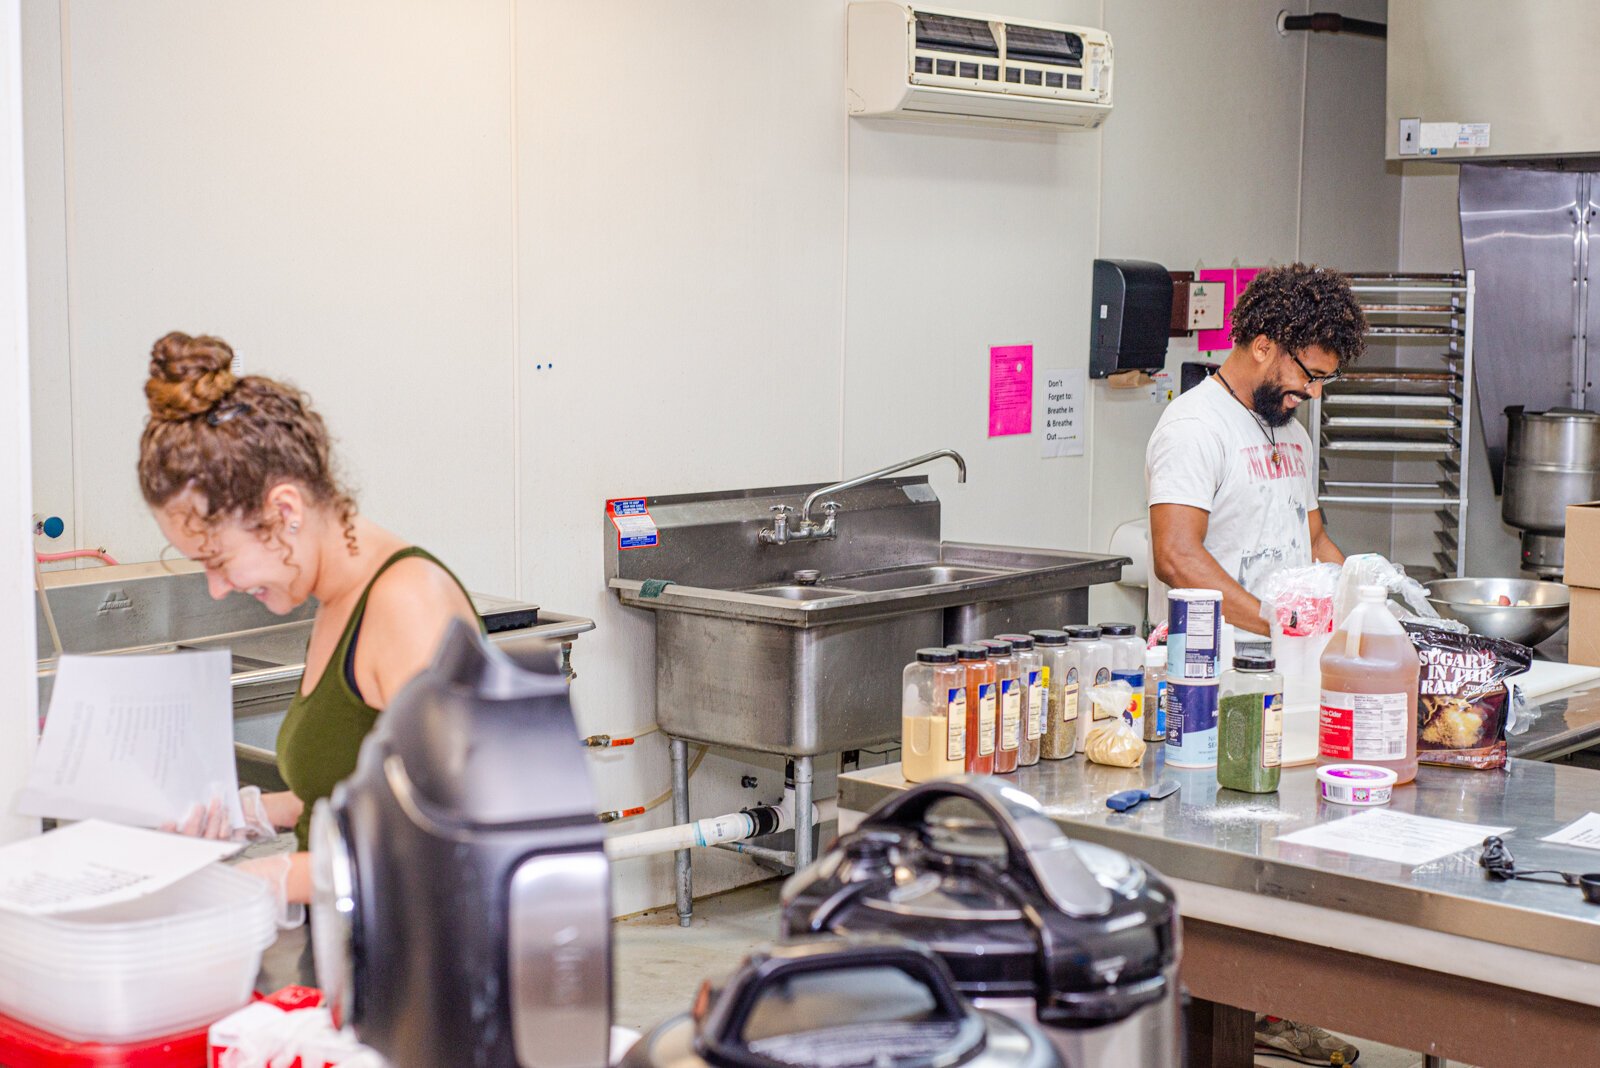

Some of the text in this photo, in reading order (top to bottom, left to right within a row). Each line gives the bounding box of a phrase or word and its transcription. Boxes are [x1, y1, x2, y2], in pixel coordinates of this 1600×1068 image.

[1048, 393, 1064, 401] Forget
[1047, 406, 1067, 414] Breathe
[1419, 650, 1483, 669] SUGAR
[1427, 664, 1494, 684] IN THE
[1420, 679, 1461, 695] RAW
[1328, 710, 1342, 718] Cider
